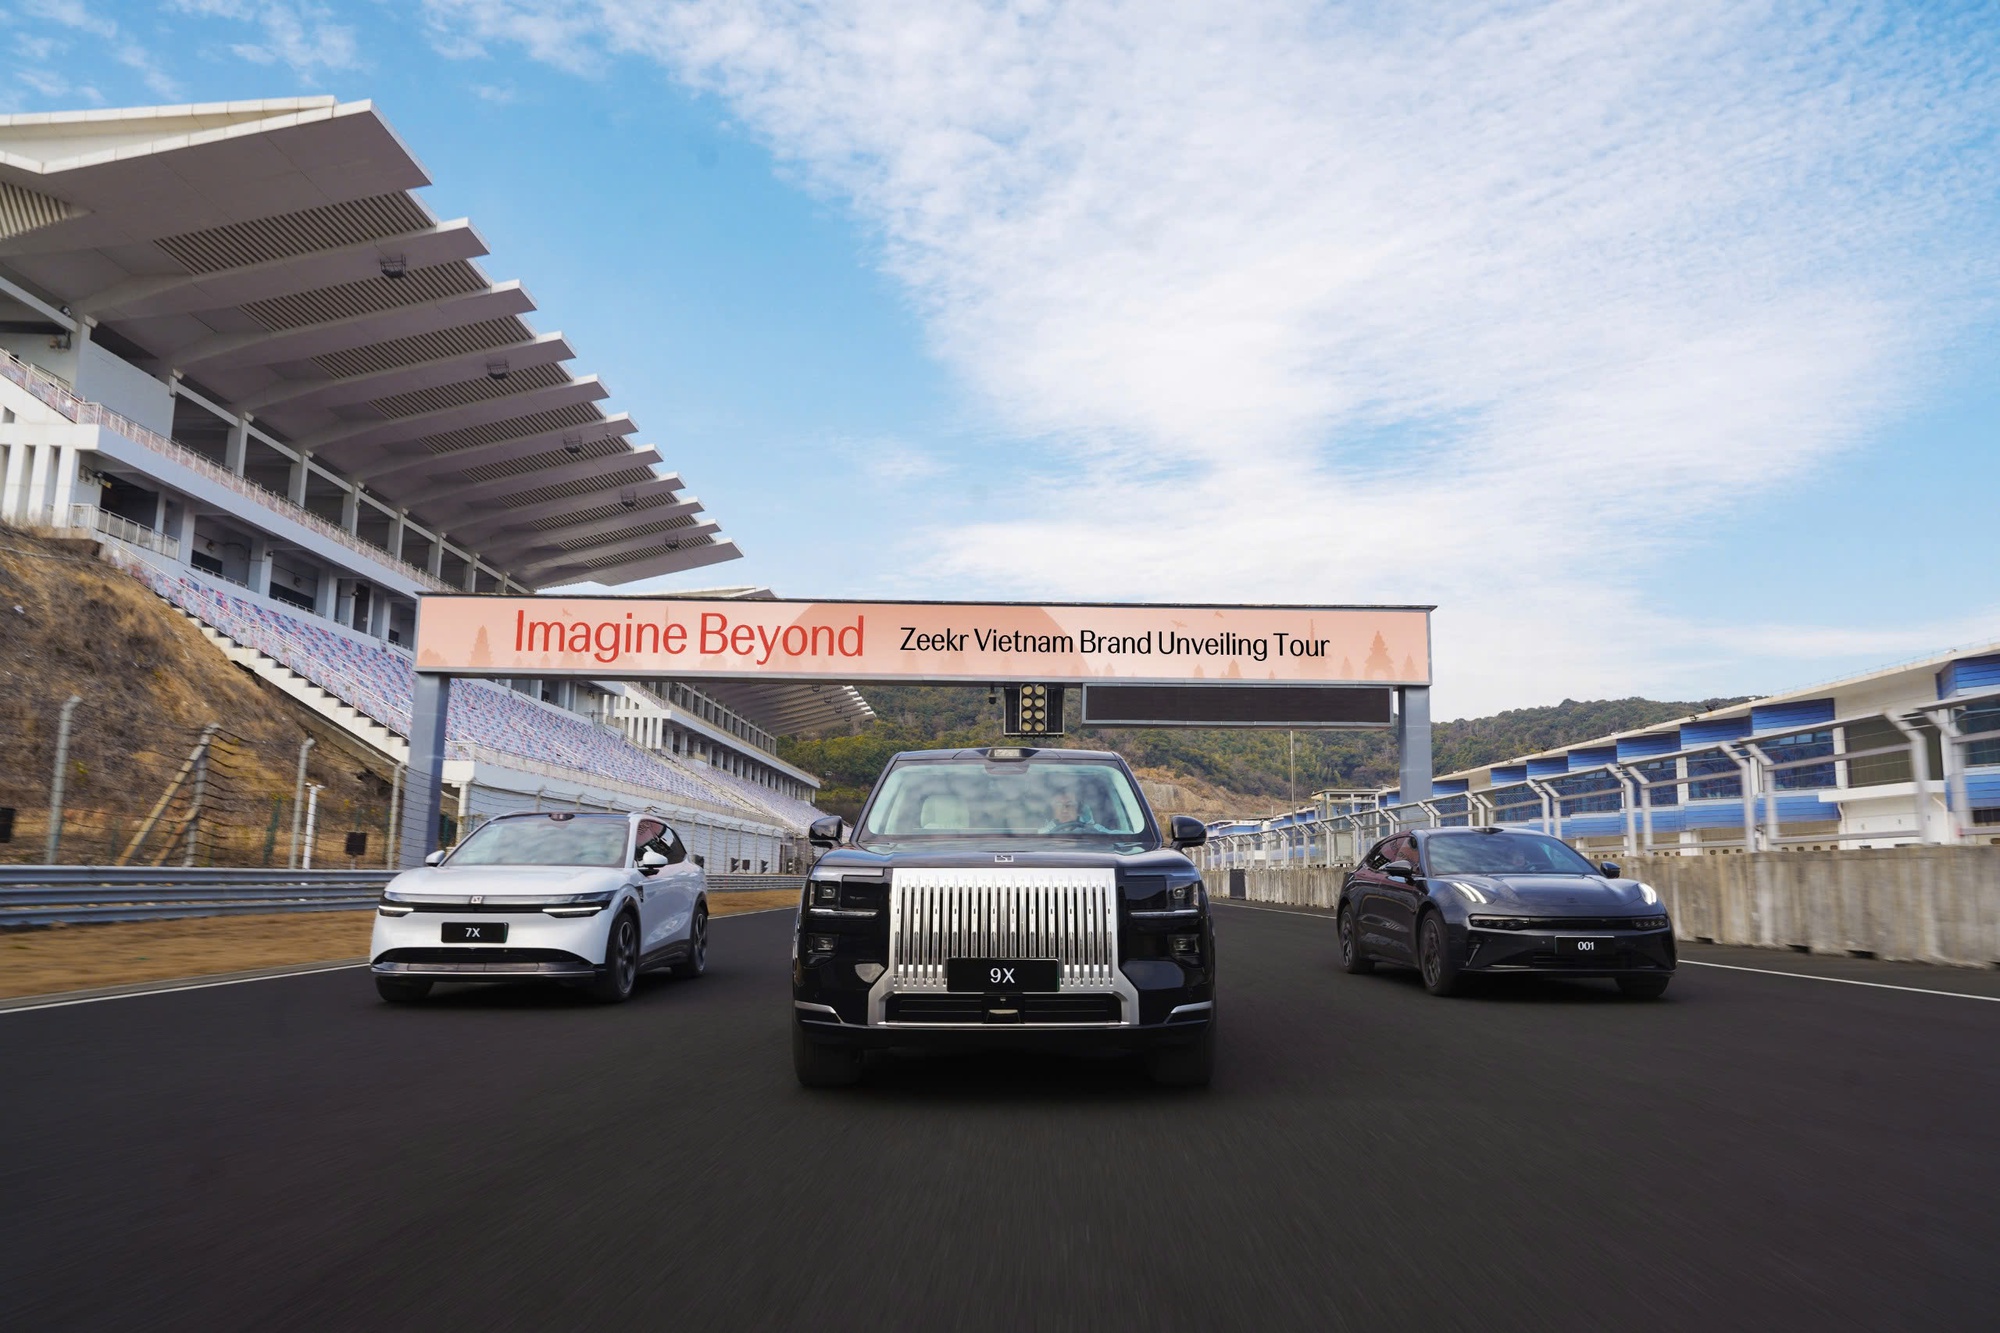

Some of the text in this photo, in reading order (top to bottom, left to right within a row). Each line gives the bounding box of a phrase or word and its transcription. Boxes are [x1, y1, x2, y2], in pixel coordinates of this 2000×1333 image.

[514, 609, 865, 665] Imagine Beyond
[899, 627, 1331, 662] Zeekr Vietnam Brand Unveiling Tour
[465, 927, 481, 938] 7X
[1577, 941, 1595, 951] 001
[989, 967, 1015, 984] 9X
